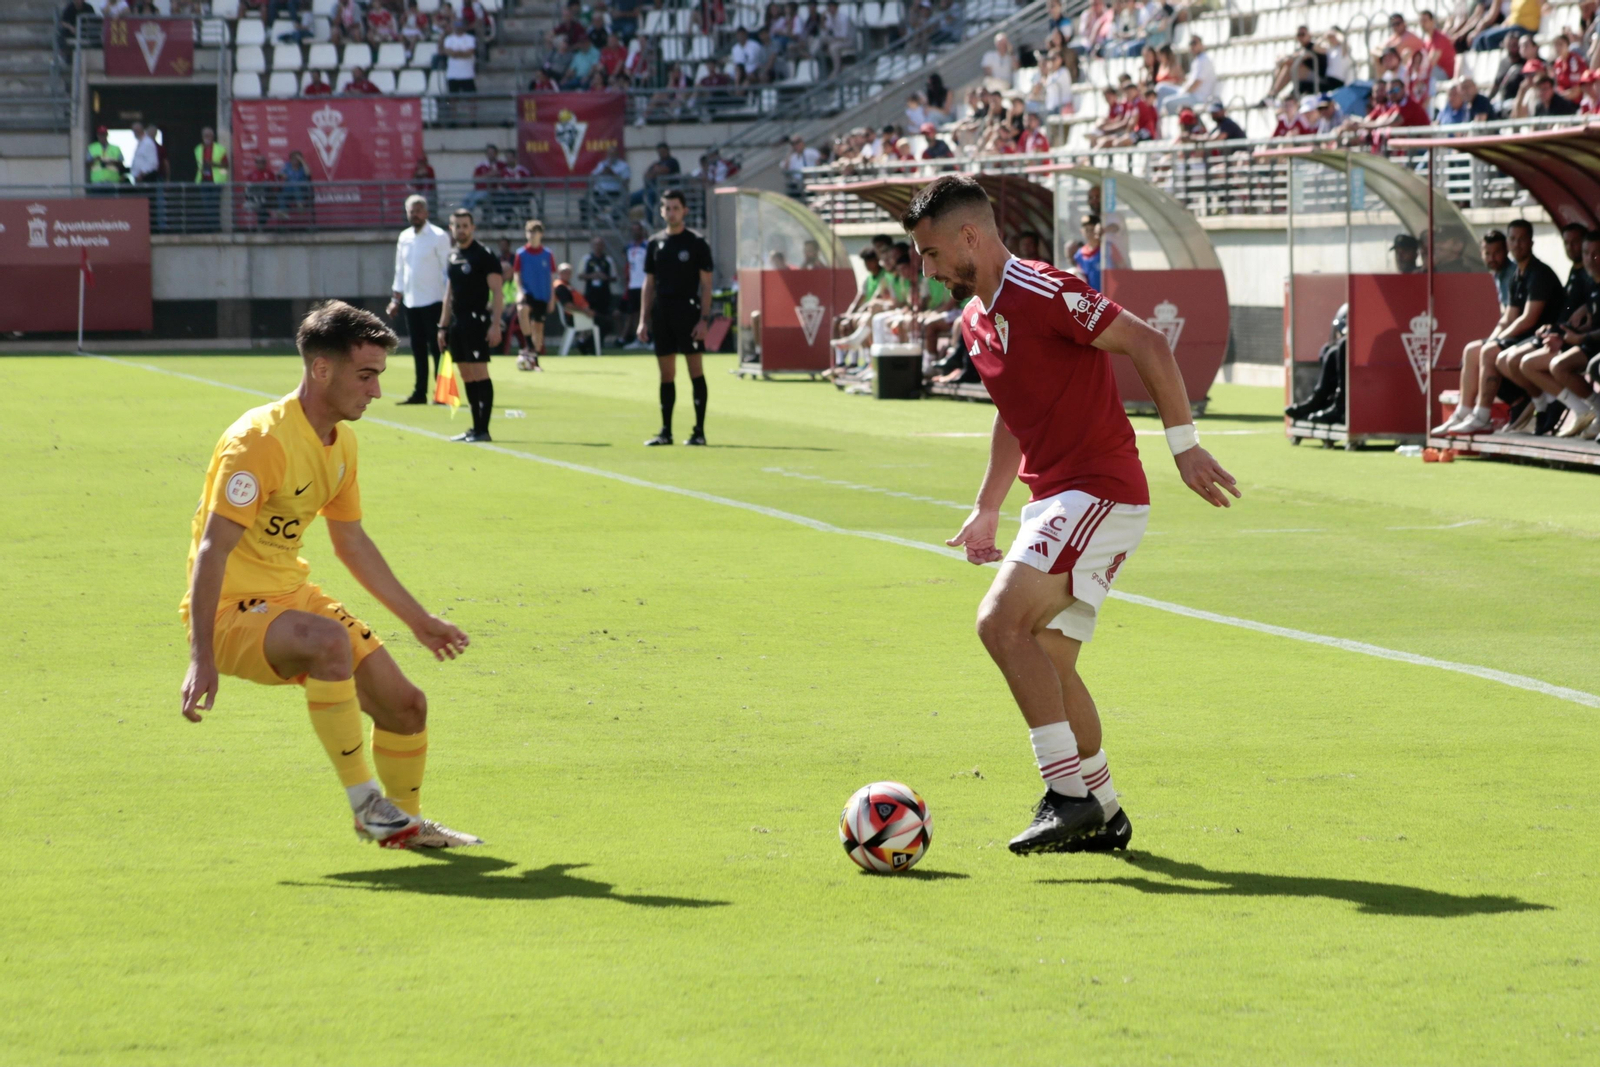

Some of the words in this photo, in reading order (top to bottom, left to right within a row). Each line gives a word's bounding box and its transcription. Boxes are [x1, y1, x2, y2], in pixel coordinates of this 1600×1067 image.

[53, 220, 130, 233] Ayuntamiento
[53, 235, 69, 247] de
[70, 235, 109, 246] Murcia
